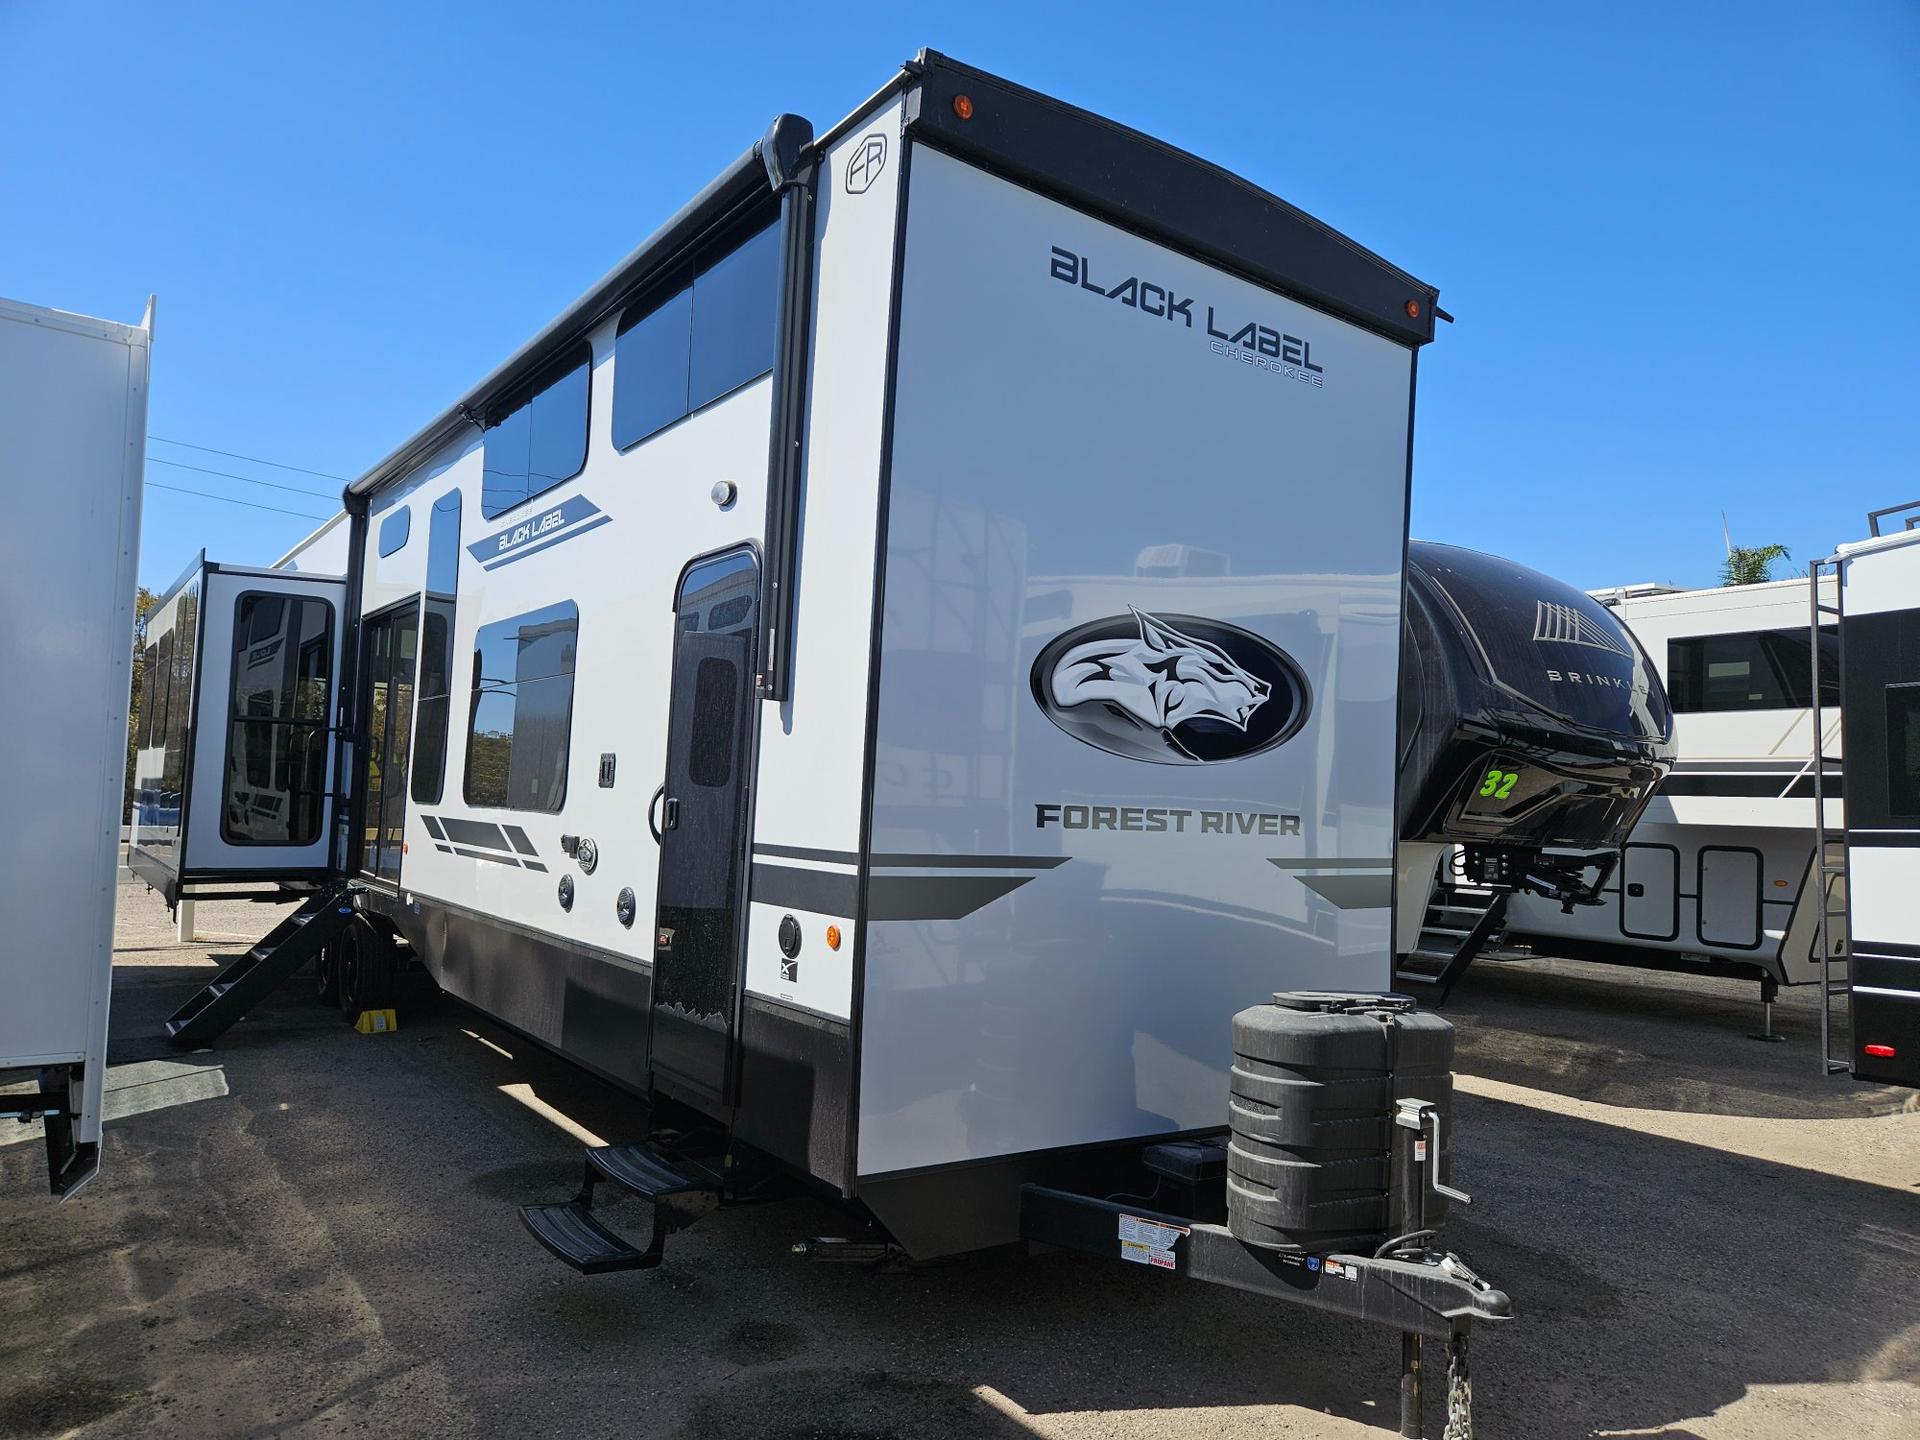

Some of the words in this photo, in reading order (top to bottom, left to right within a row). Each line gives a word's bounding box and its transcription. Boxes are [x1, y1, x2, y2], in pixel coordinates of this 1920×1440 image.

[1050, 245, 1195, 329] BLACK
[1206, 305, 1324, 374] LABEL
[1209, 340, 1324, 389] CHEROKEE
[498, 522, 531, 551] BLACK
[531, 508, 566, 536] LABEL
[1479, 770, 1519, 799] 32
[1035, 803, 1193, 833] FOREST
[1199, 810, 1301, 837] RIVER
[1150, 1257, 1175, 1268] PROPANE
